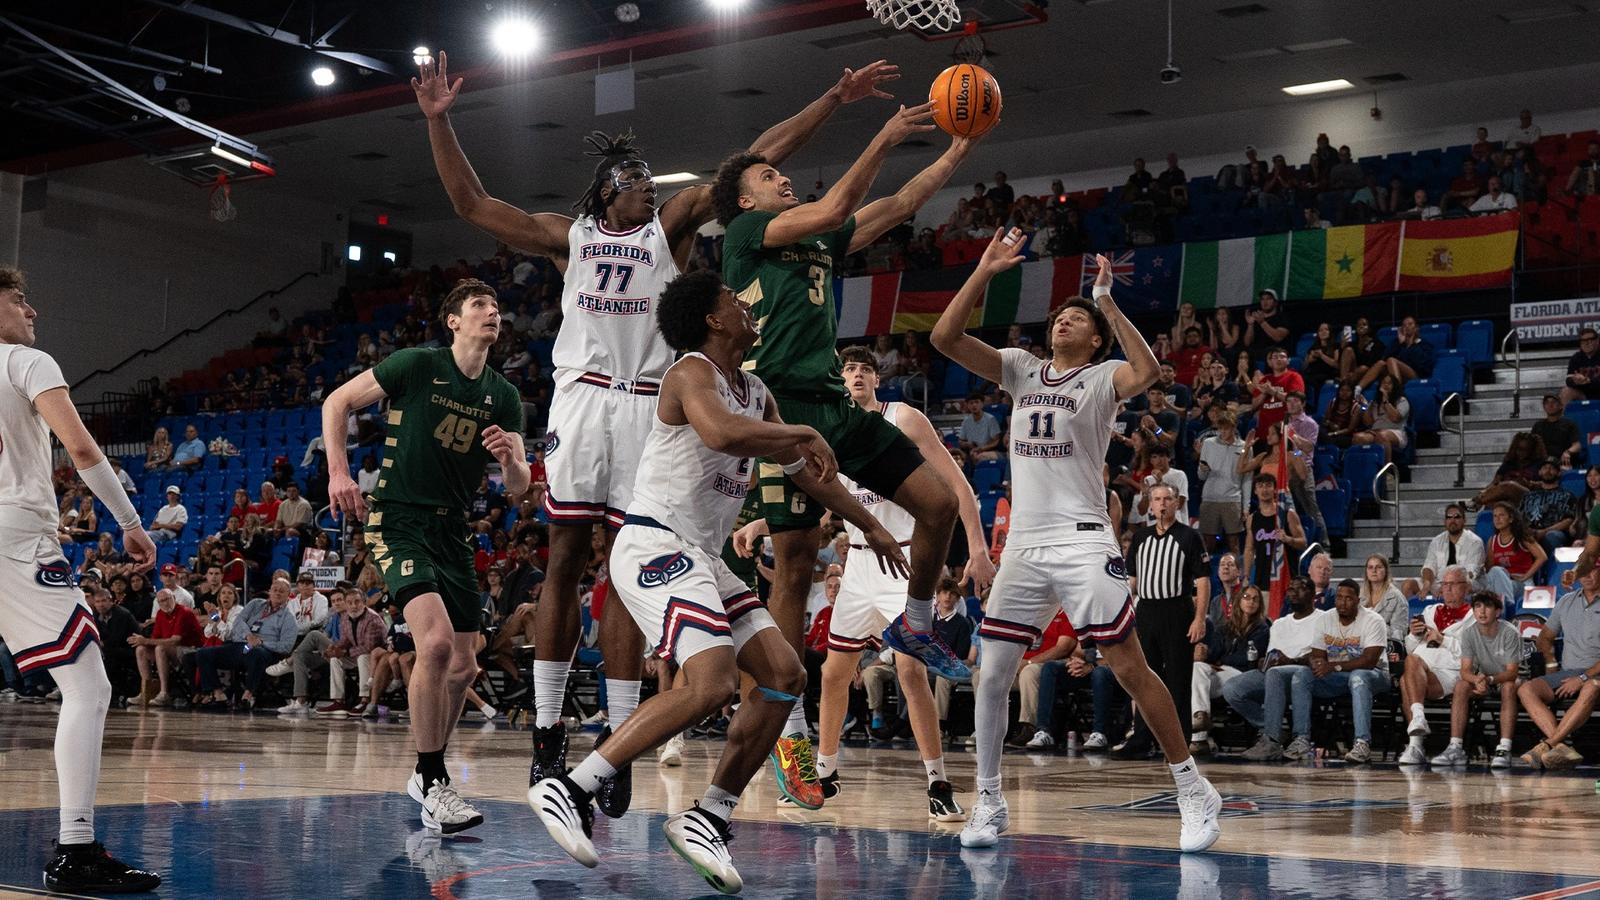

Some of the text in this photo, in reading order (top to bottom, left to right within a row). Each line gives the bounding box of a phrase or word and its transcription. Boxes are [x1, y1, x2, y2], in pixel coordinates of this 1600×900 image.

[956, 73, 970, 121] Wilson
[580, 243, 653, 267] FLORIDA
[595, 261, 635, 294] 77
[808, 264, 825, 306] 3
[577, 292, 650, 315] ATLANTIC
[1514, 304, 1570, 318] FLORIDA
[1516, 322, 1580, 339] STUDENT
[431, 394, 492, 420] CHARLOTTE
[1017, 393, 1078, 414] FLORIDA
[433, 413, 478, 454] 49
[1028, 411, 1055, 440] 11
[1015, 440, 1073, 458] ATLANTIC
[315, 580, 336, 588] CTION
